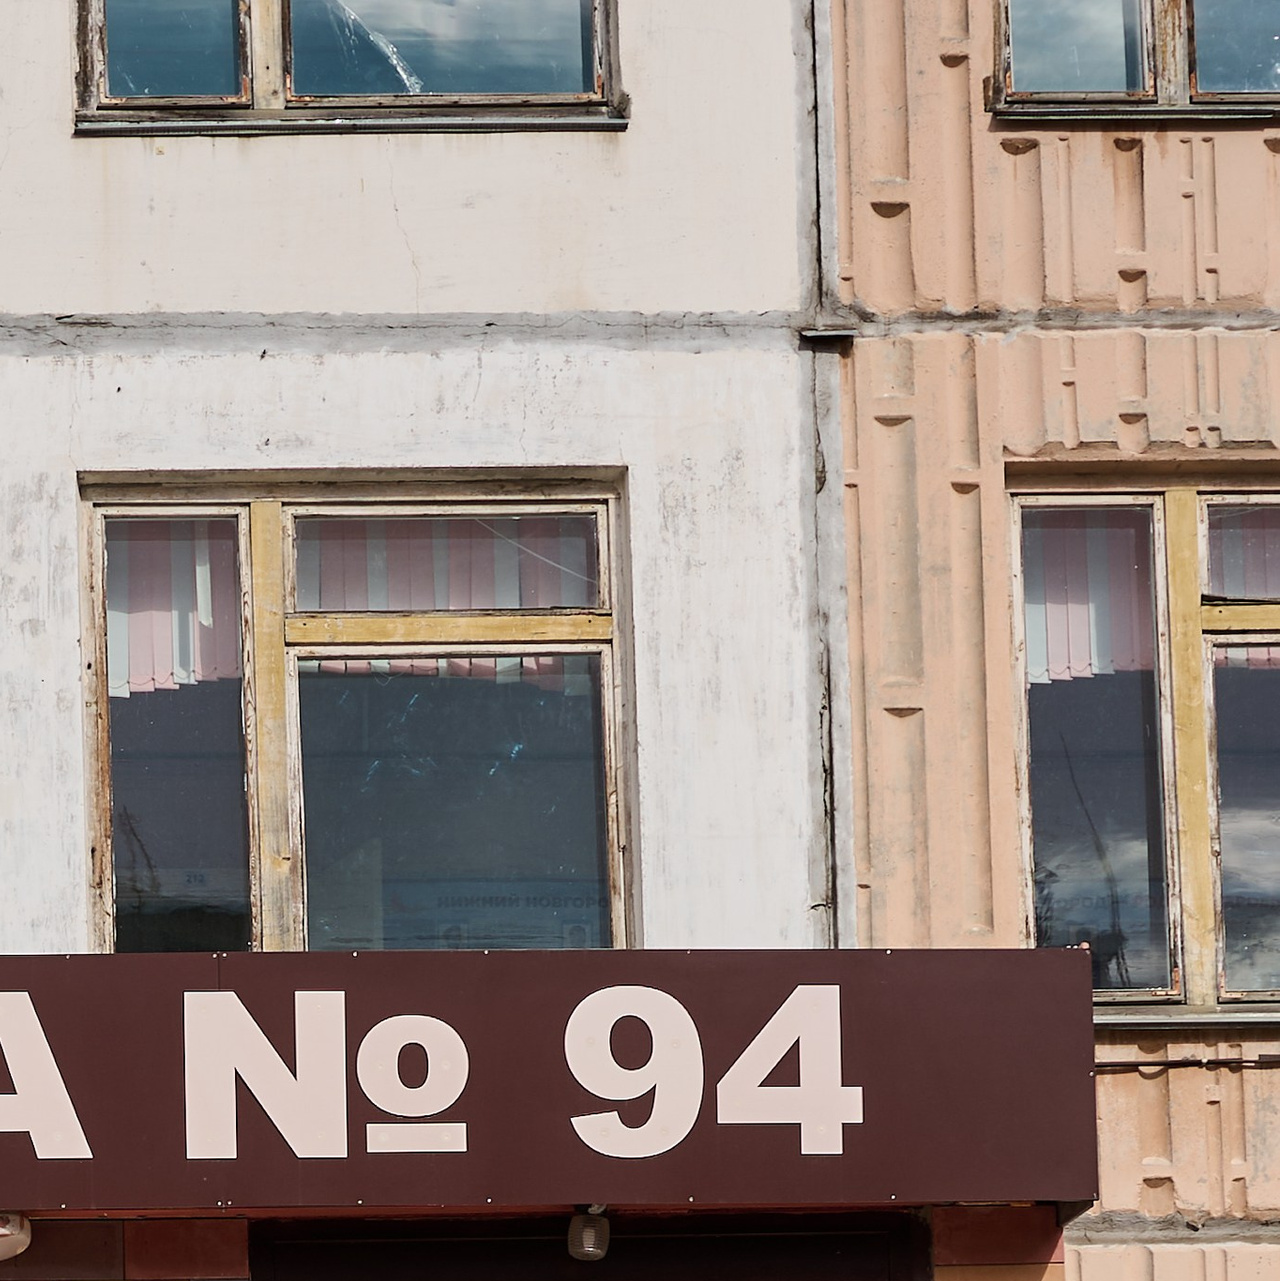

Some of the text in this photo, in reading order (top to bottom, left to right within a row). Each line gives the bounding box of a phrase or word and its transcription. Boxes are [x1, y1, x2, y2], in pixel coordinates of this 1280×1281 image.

[438, 893, 609, 909] НИЖНИЙ НОВГОРО
[184, 991, 469, 1160] №
[565, 985, 864, 1158] 94
